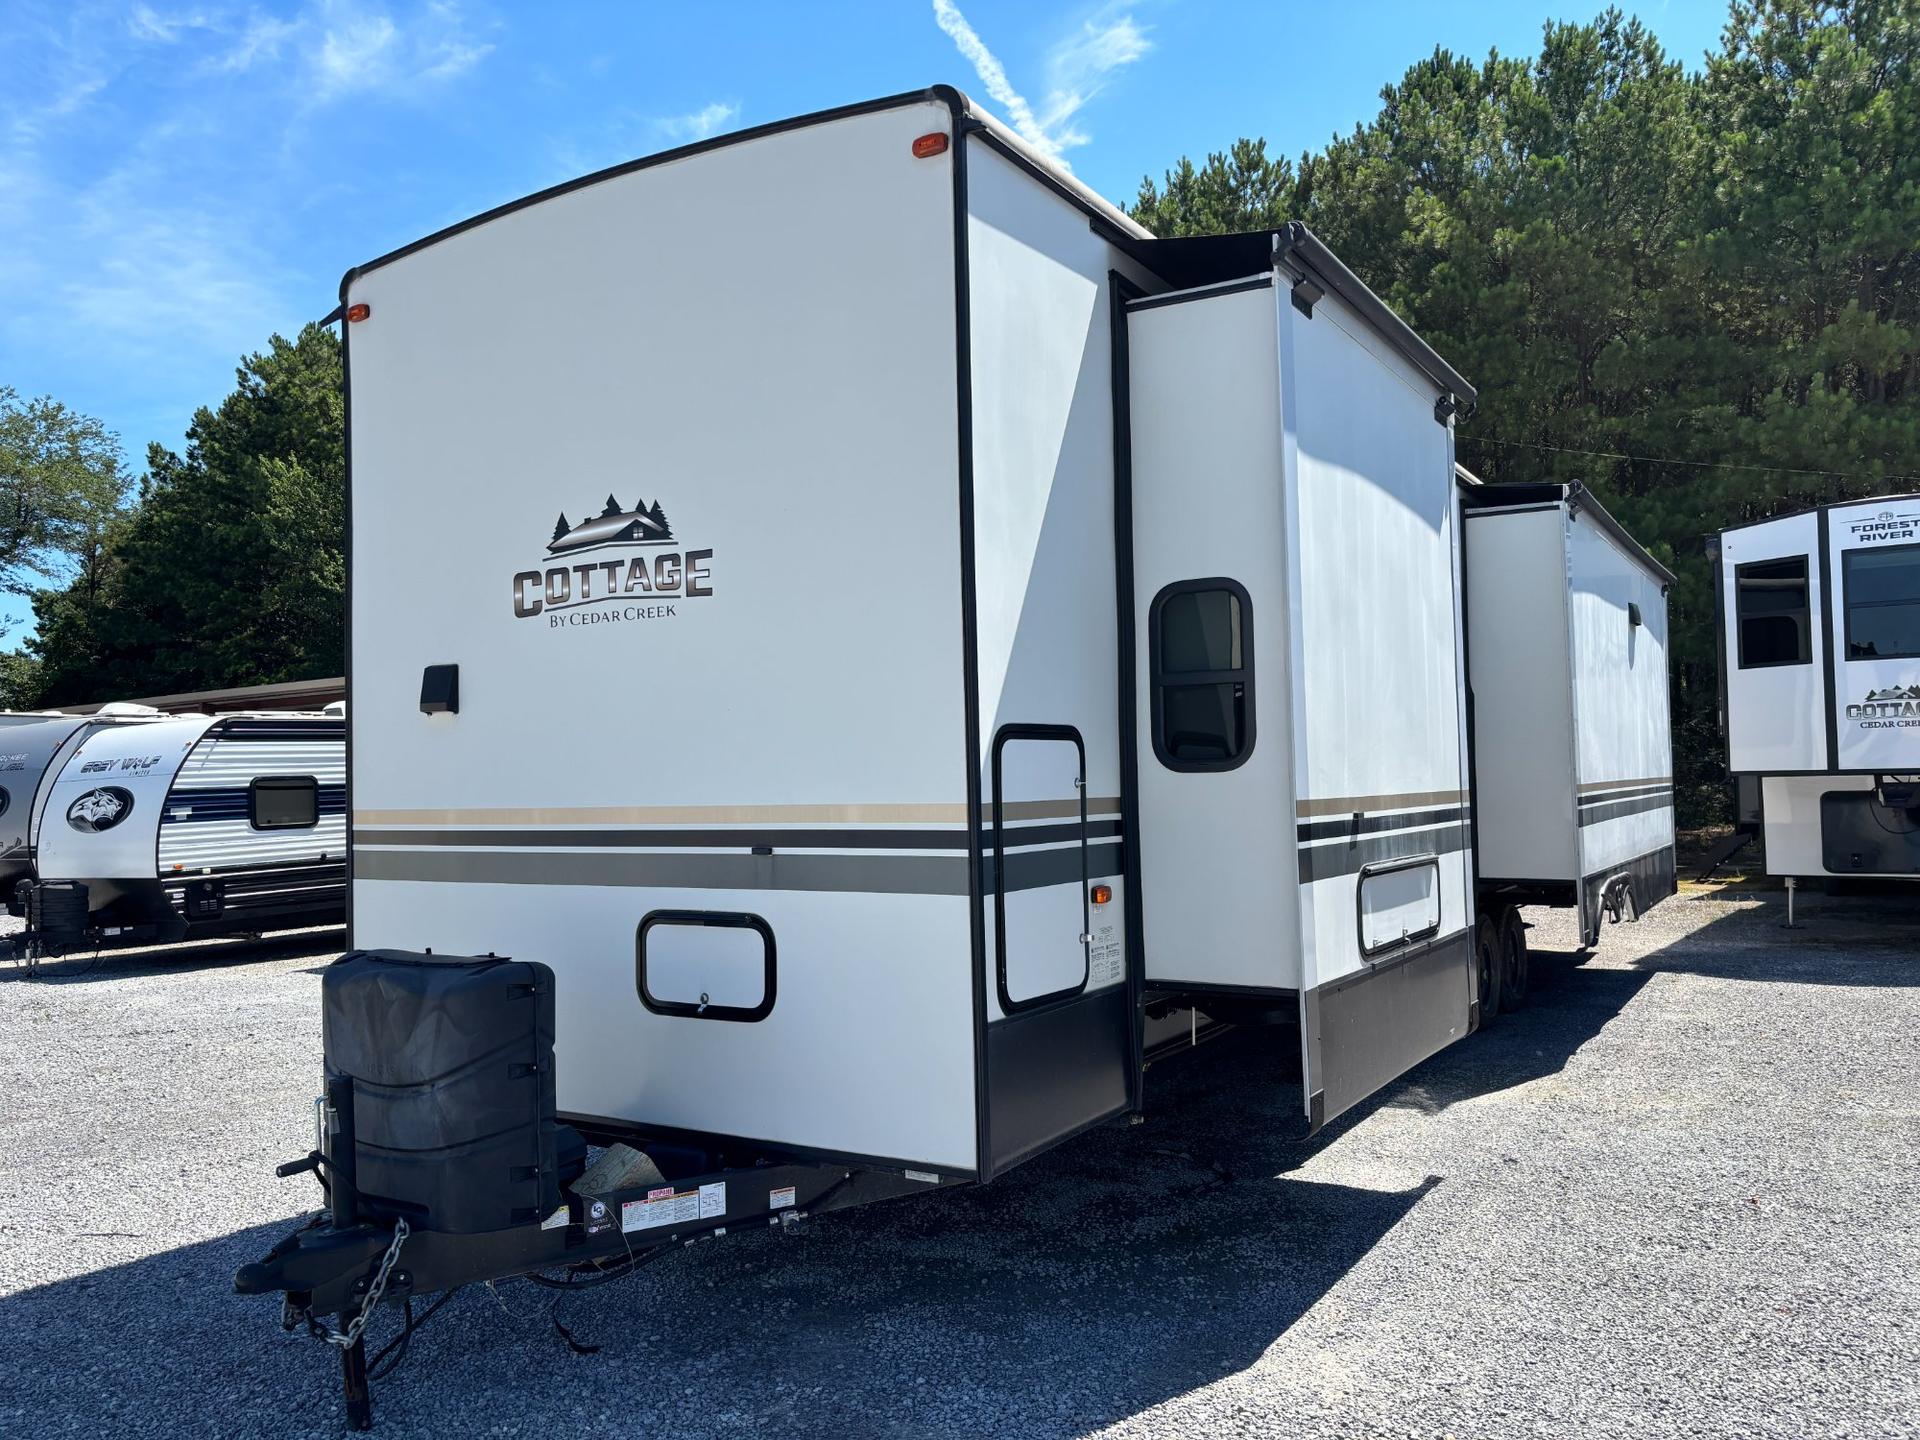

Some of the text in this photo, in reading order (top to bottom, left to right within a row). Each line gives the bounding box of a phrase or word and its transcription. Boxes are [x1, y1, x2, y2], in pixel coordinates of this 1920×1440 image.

[1851, 519, 1920, 533] FOREST
[1859, 530, 1914, 542] RIVER
[513, 548, 713, 619] COTTAGE
[550, 604, 677, 628] BY CEDAR CREEK
[1860, 720, 1895, 729] CEDAR
[80, 755, 162, 774] GREY WOLF
